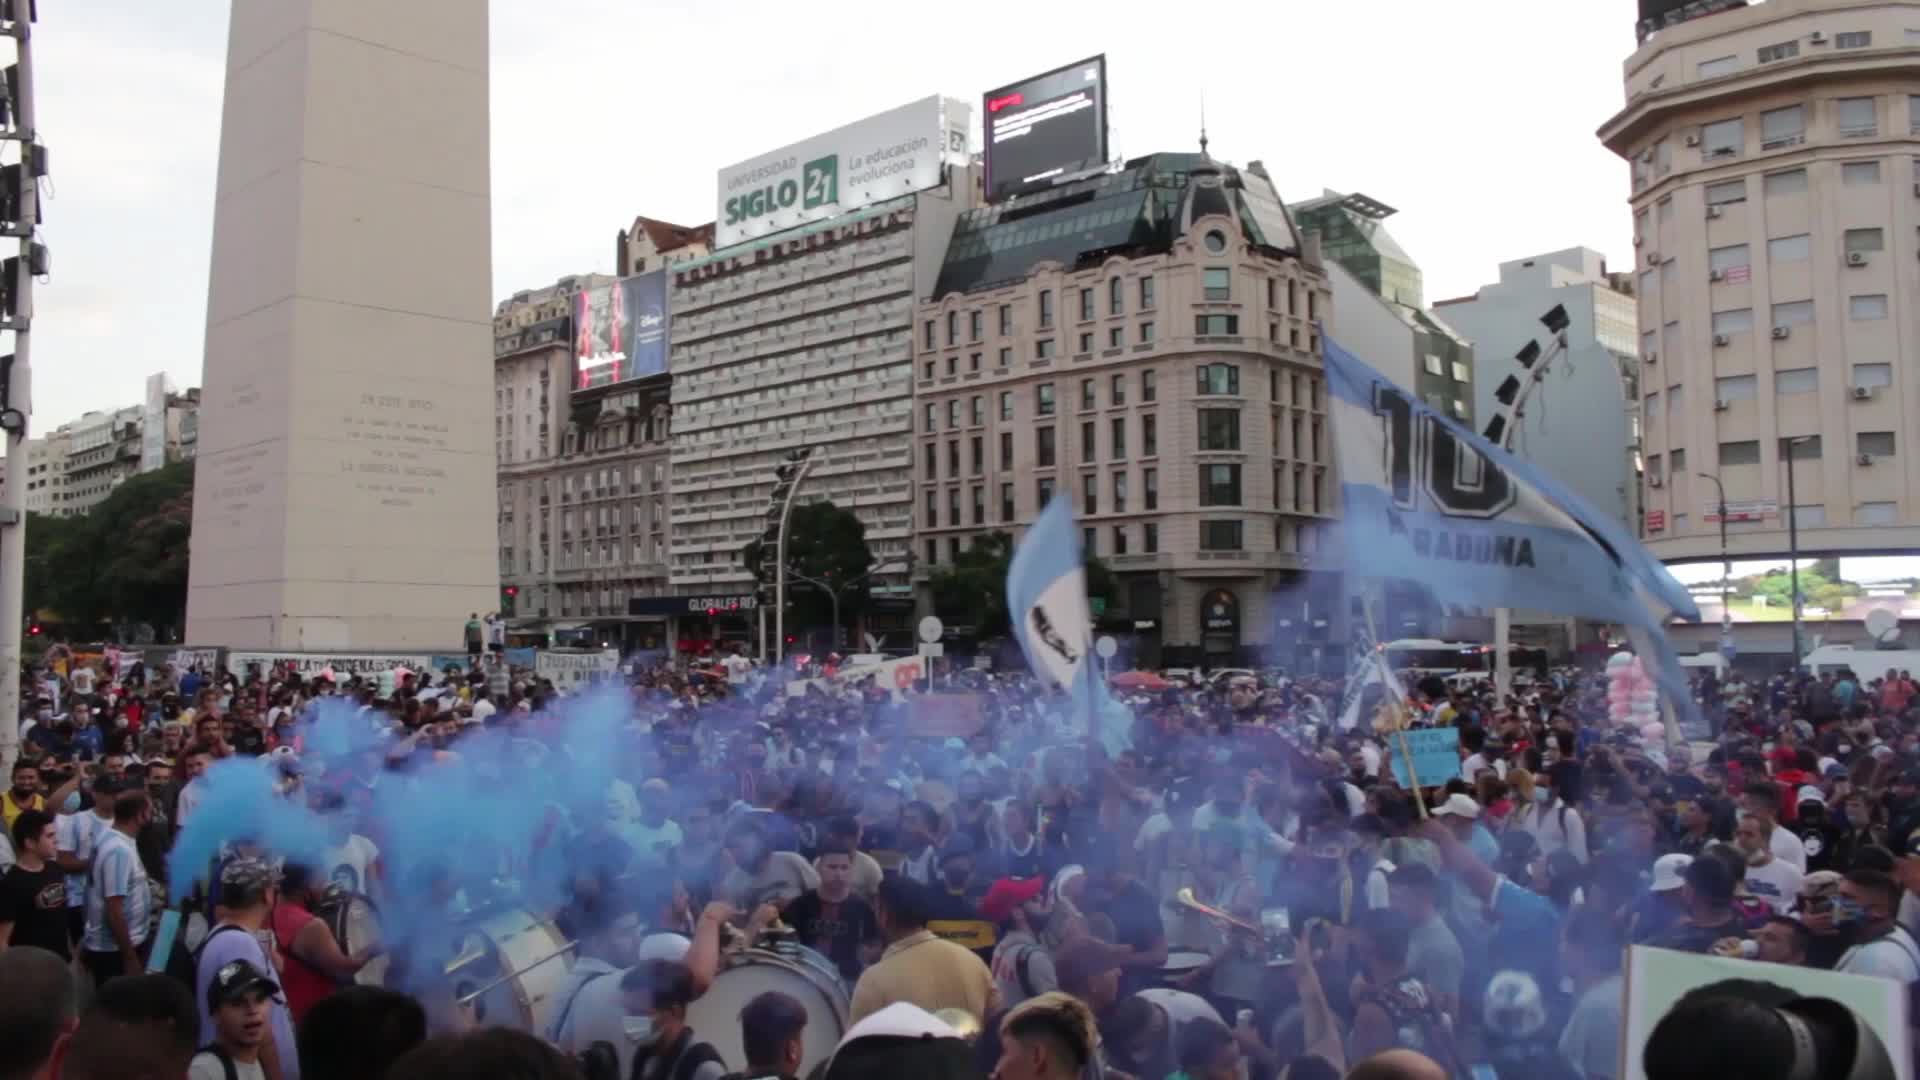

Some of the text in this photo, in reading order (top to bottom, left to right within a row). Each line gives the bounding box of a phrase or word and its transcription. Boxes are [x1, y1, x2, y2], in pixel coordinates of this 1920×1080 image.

[849, 136, 928, 170] La educación
[727, 157, 797, 190] UNIVERSIDAD
[849, 158, 915, 187] evoluciona
[725, 167, 832, 226] SIGLO 21
[1370, 378, 1518, 521] 10
